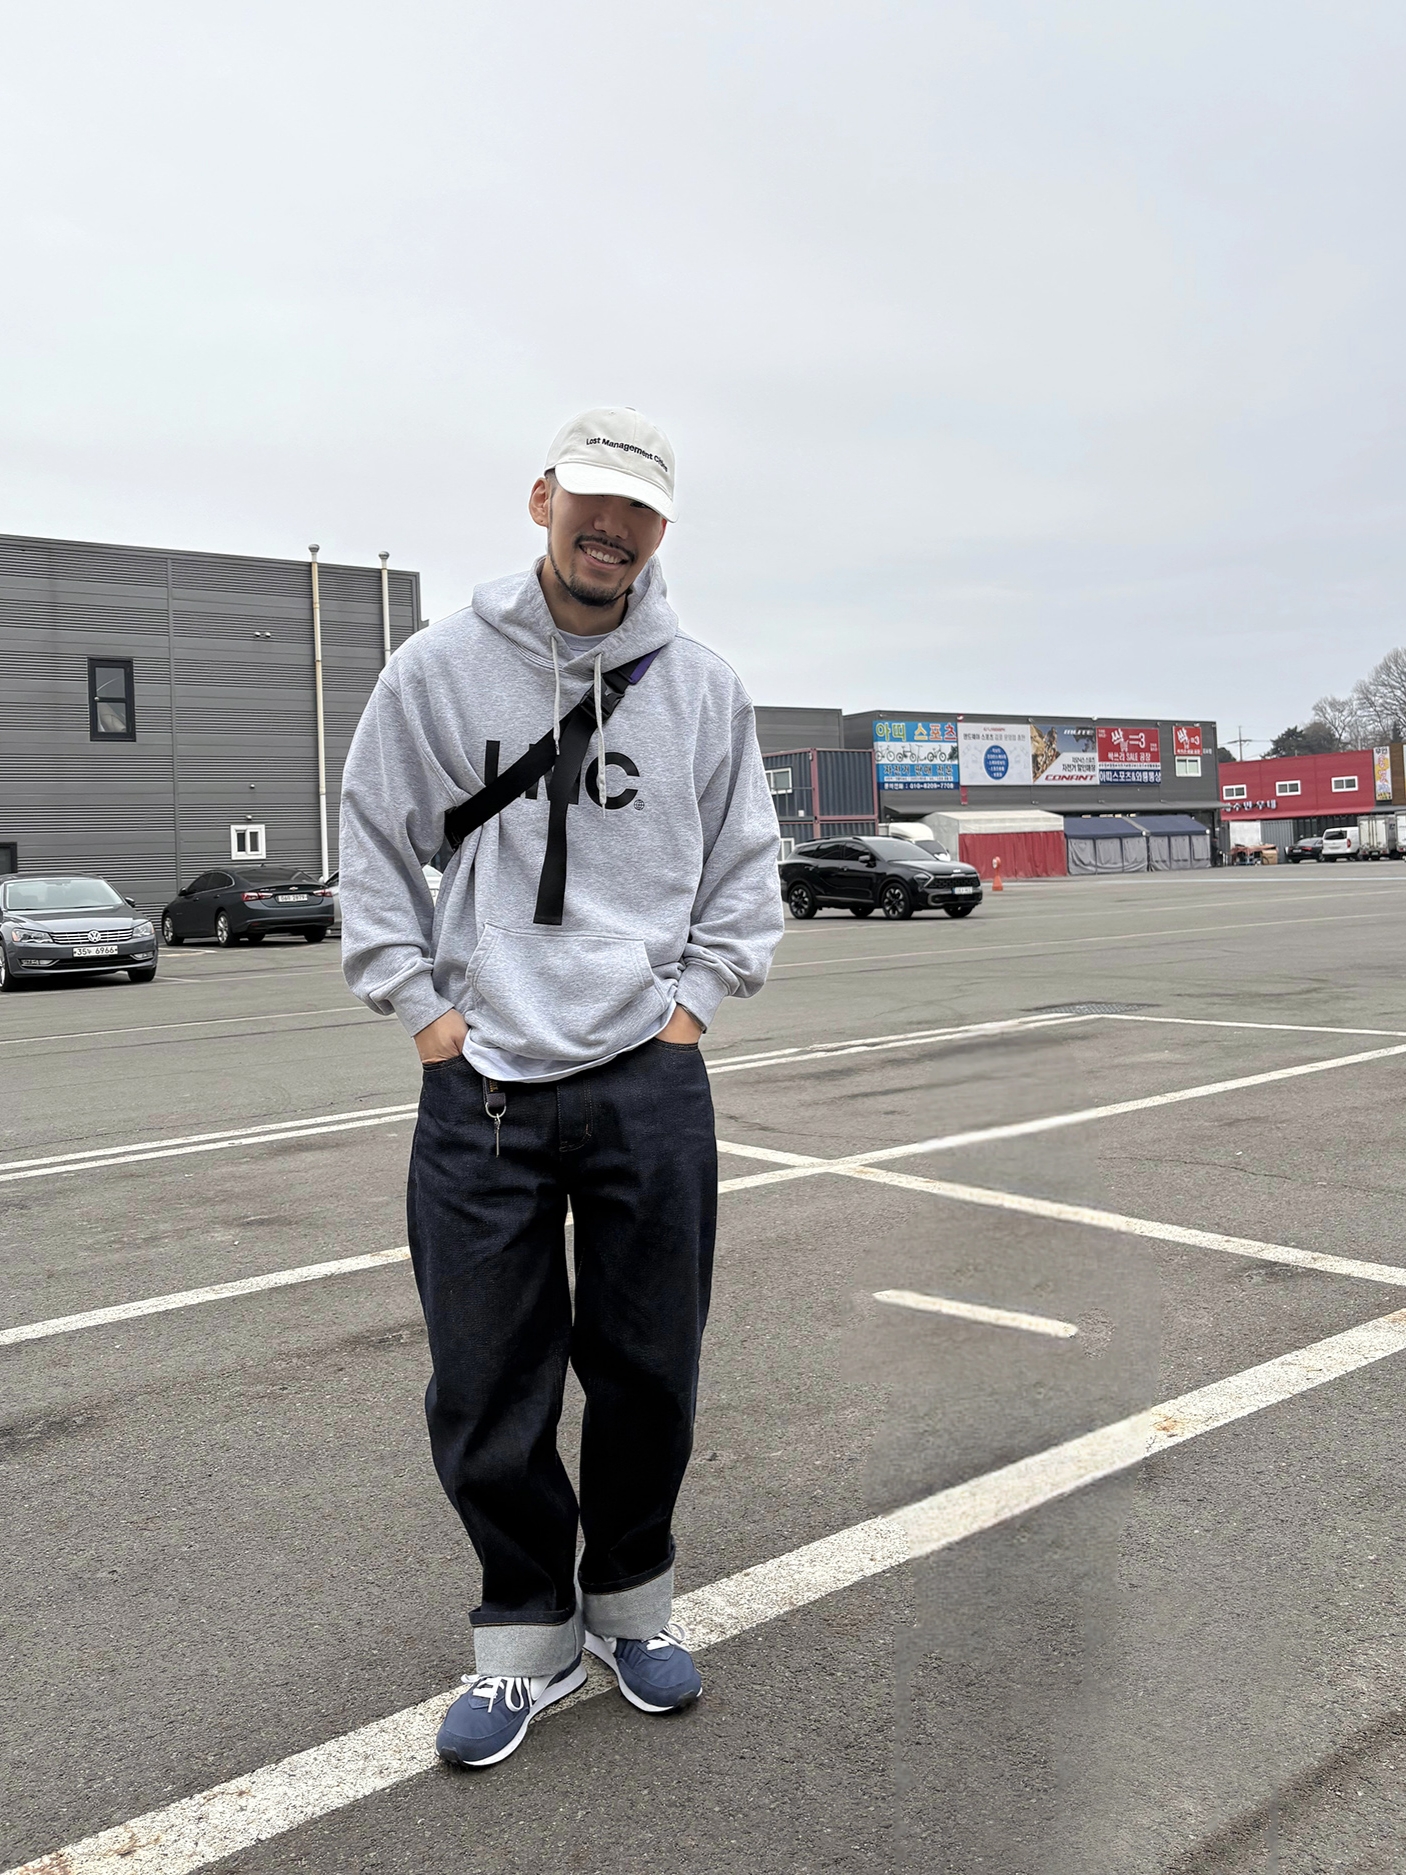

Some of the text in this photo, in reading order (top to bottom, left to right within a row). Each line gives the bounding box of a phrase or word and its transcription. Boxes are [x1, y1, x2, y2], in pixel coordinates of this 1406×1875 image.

[586, 437, 601, 446] Lost
[601, 438, 653, 461] Management
[875, 722, 957, 742] 아띠 스포츠
[1125, 752, 1138, 761] SALE
[884, 765, 911, 776] 자전거
[95, 947, 114, 955] 6966
